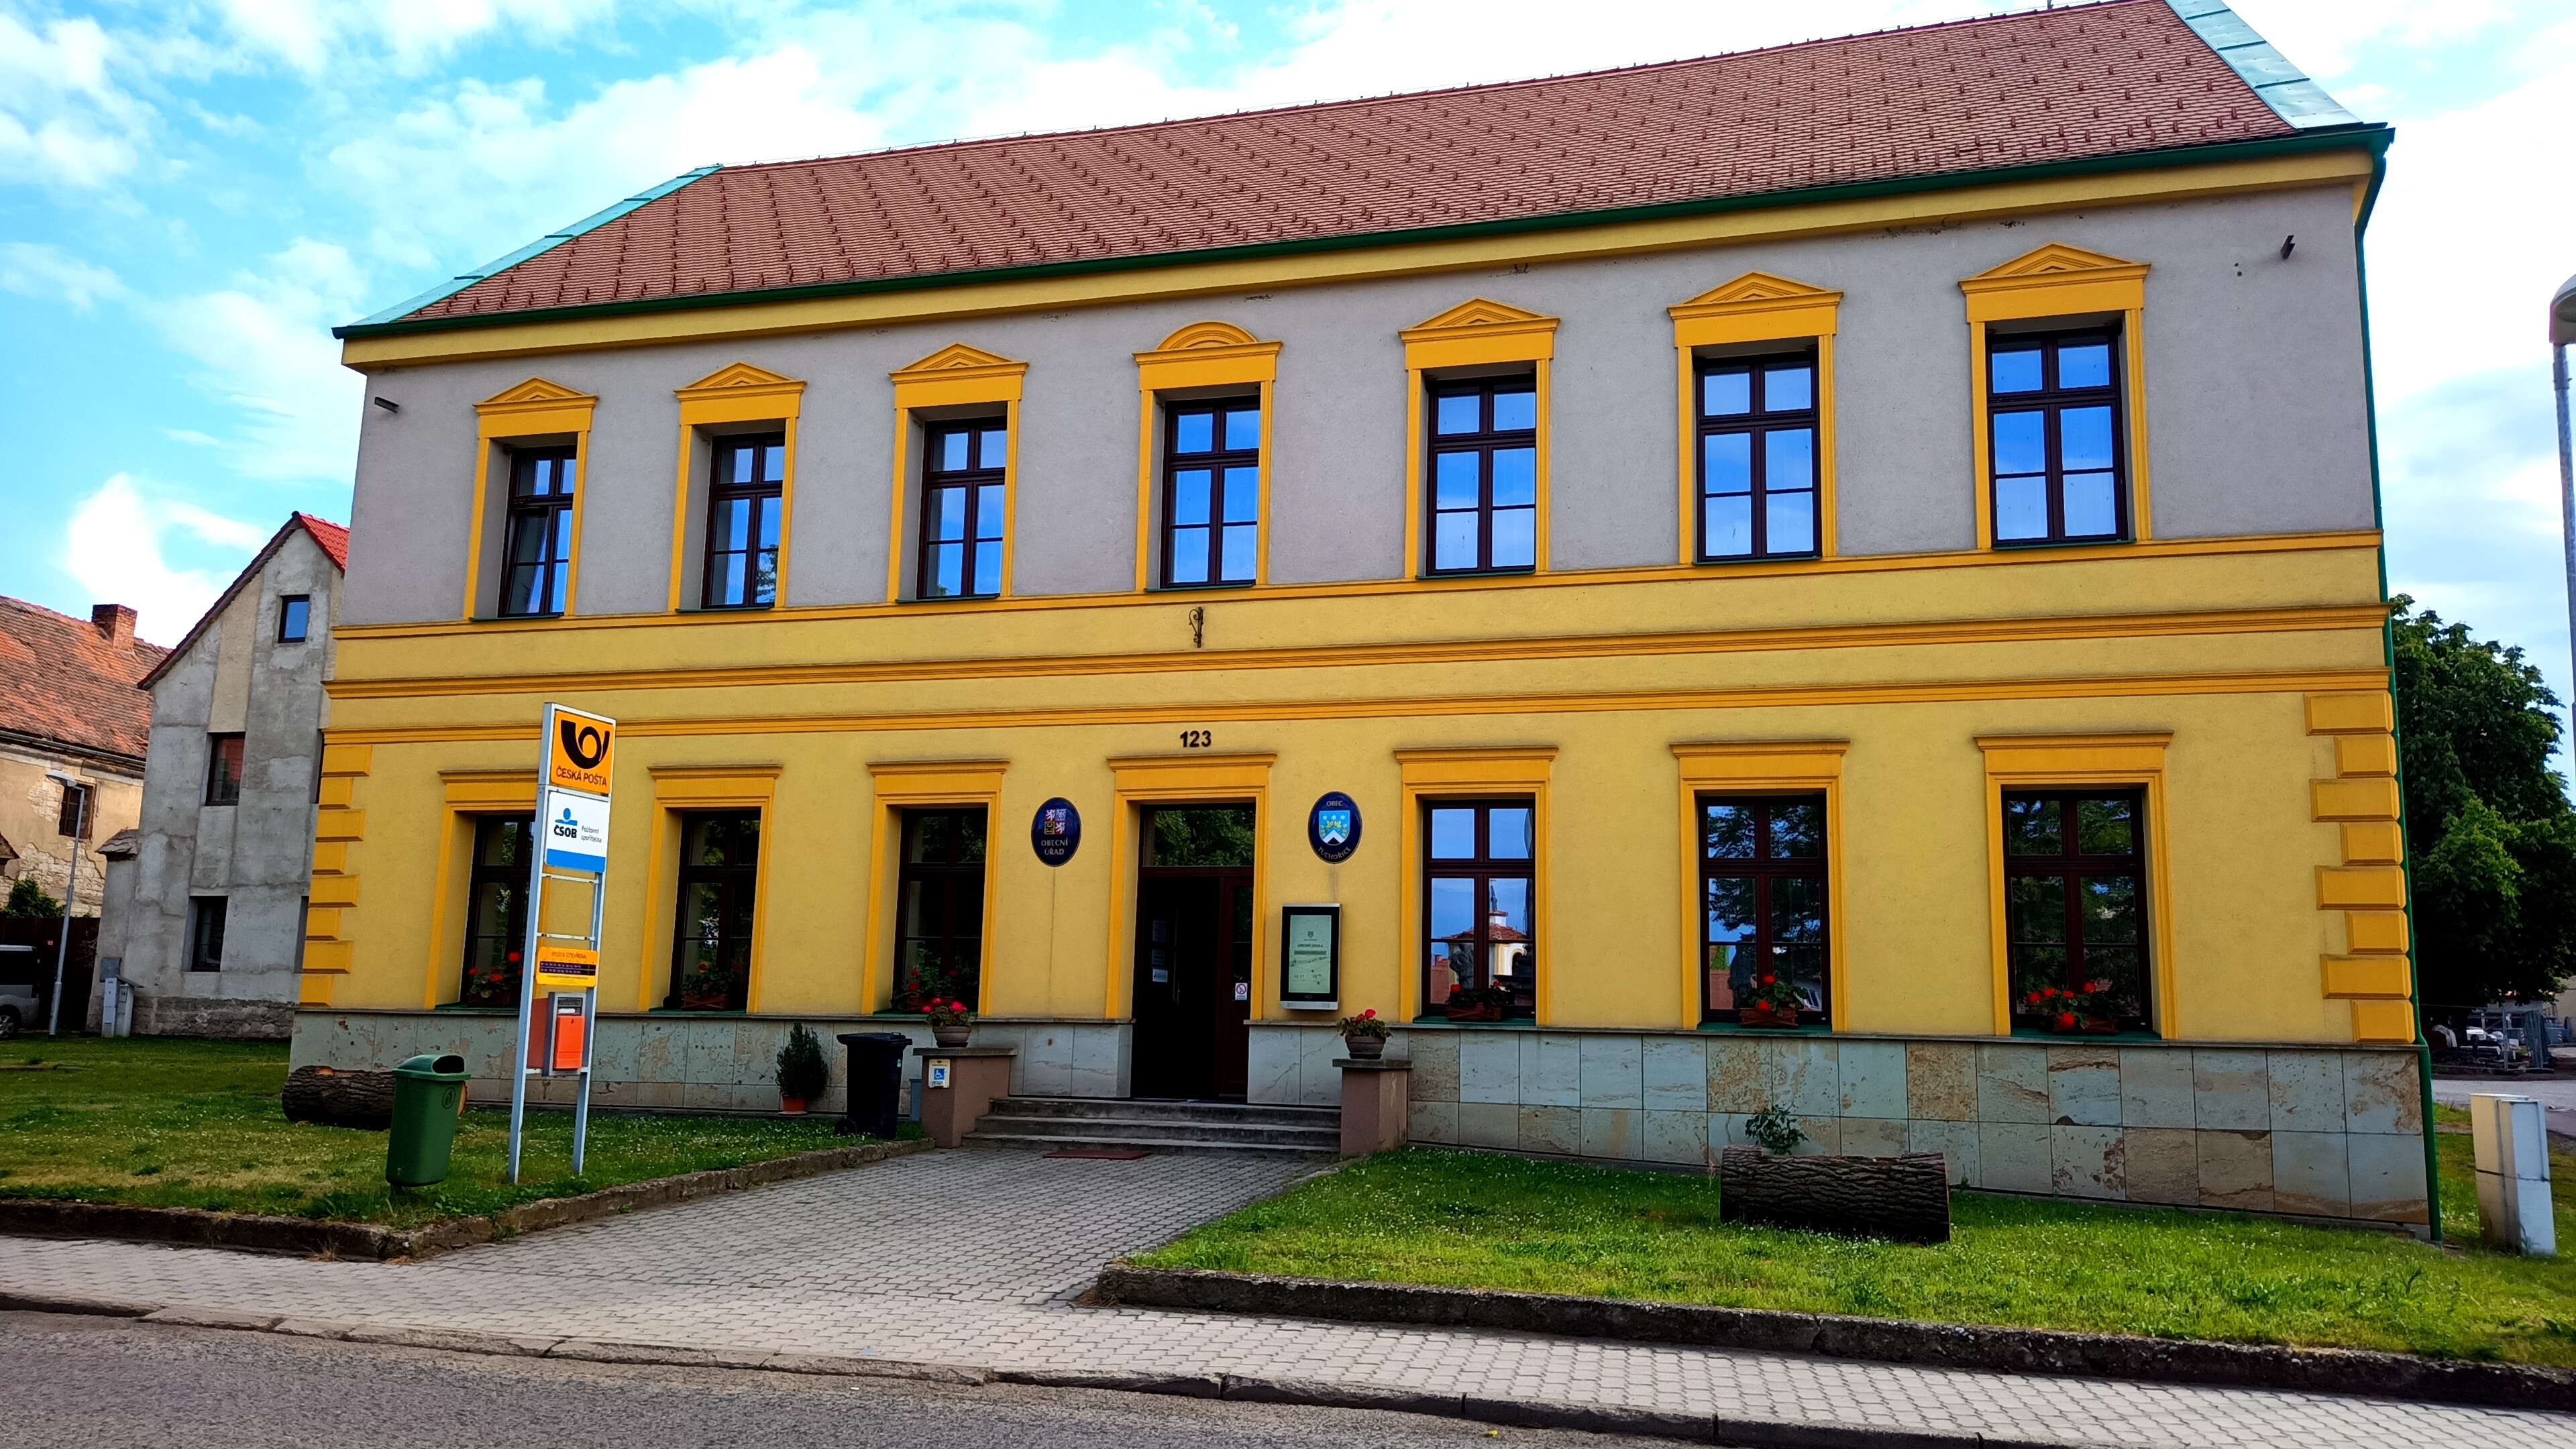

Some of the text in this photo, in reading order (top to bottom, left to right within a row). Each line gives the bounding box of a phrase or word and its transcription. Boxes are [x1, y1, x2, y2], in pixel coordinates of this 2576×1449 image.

[1180, 730, 1212, 747] 123
[556, 765, 607, 787] ČESKÁ POŠTA
[554, 824, 577, 838] ČSOB
[1041, 838, 1068, 846] OBECNÍ
[1044, 847, 1064, 855] ÚŘAD
[1318, 846, 1351, 859] TUCHOŘICE
